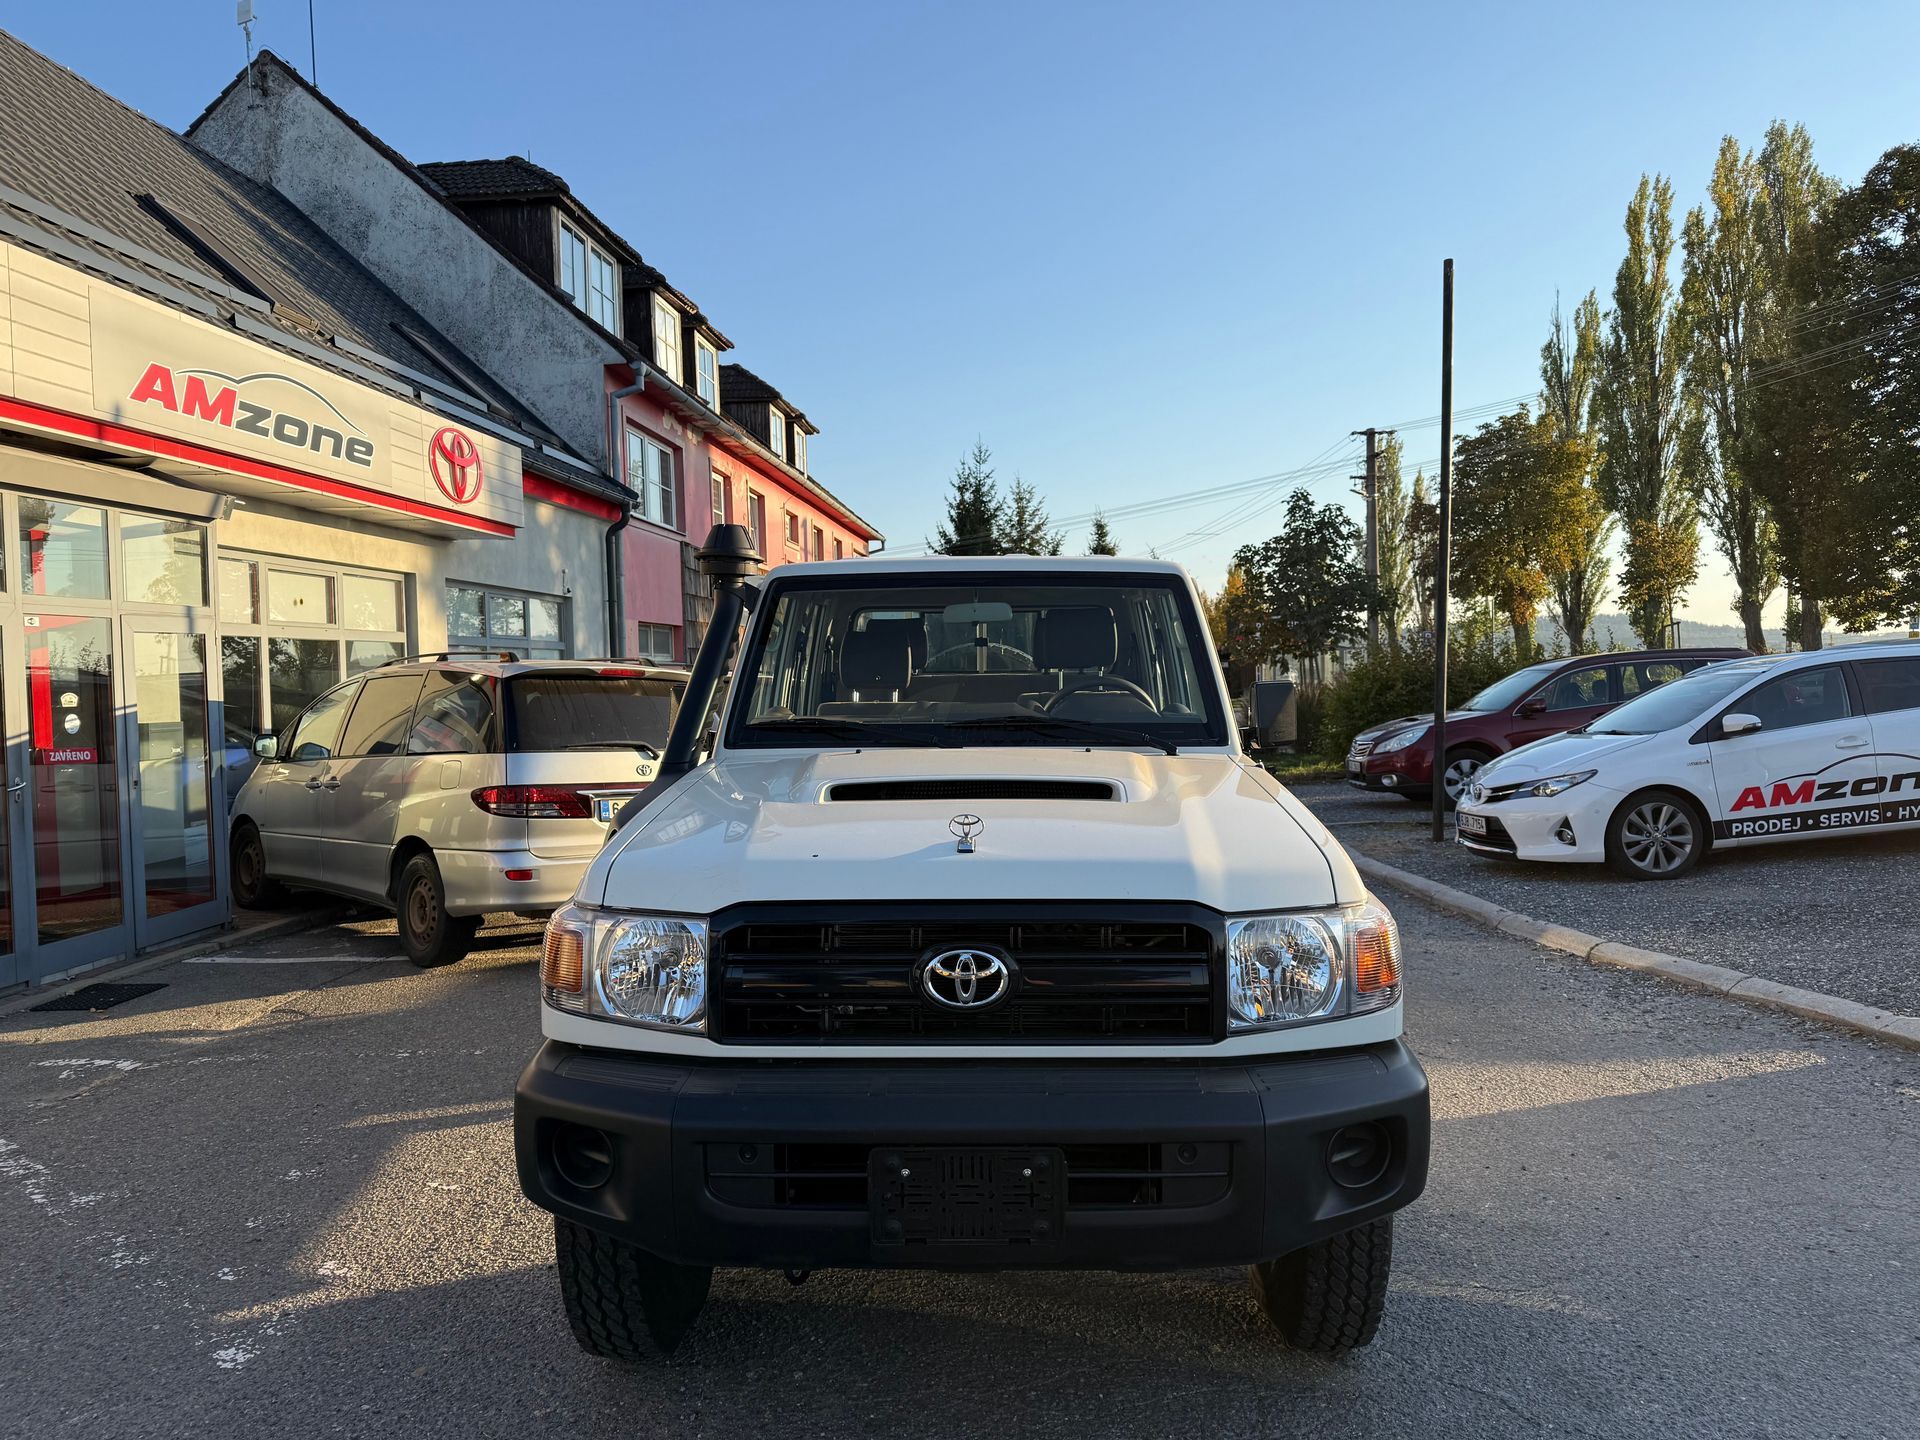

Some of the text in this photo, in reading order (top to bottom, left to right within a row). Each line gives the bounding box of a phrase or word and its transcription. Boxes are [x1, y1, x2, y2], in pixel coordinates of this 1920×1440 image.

[129, 362, 375, 468] AMzone
[49, 749, 91, 762] ZAVŘENO
[1729, 772, 1920, 812] AMzon
[1732, 817, 1801, 836] PRODEJ
[1819, 809, 1880, 827] SERVIS
